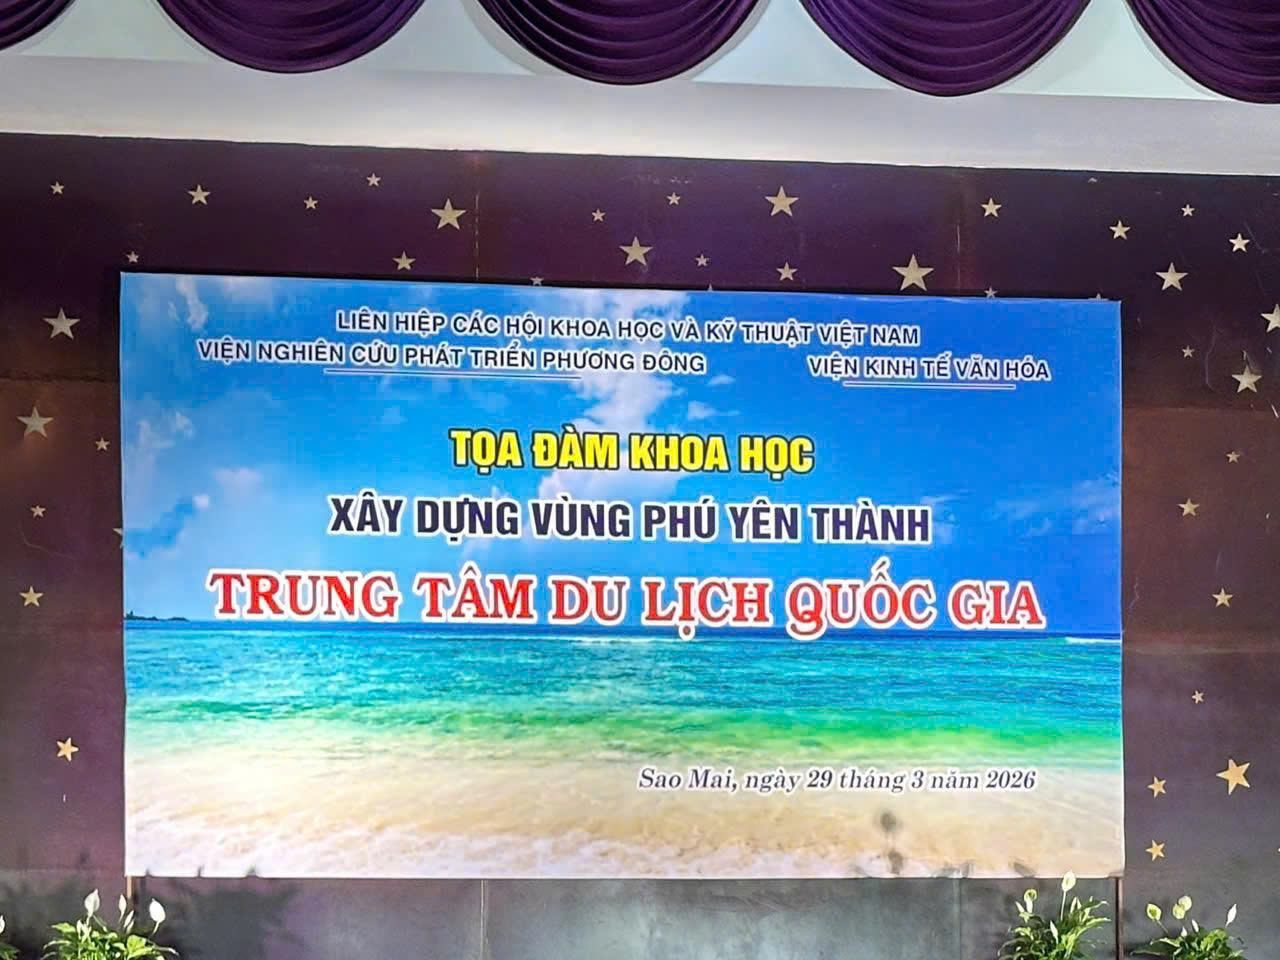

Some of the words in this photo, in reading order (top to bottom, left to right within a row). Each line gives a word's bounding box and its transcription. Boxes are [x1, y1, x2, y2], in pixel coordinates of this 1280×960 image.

[338, 310, 386, 330] LIÊN
[395, 312, 445, 337] HIỆP
[453, 313, 498, 334] CÁC
[506, 315, 543, 340] HỘI
[551, 319, 610, 337] KHOA
[618, 320, 663, 344] HỌC
[671, 318, 698, 340] VÀ
[706, 319, 734, 340] KỸ
[742, 321, 811, 346] THUẬT
[819, 323, 865, 348] VIỆT
[873, 327, 919, 344] NAM
[199, 338, 250, 362] VIỆN
[258, 341, 343, 362] NGHIÊN
[352, 342, 397, 364] CỨU
[405, 343, 461, 365] PHÁT
[472, 342, 534, 368] TRIỂN
[543, 349, 634, 370] PHƯƠNG
[643, 350, 704, 371] ĐÔNG
[808, 355, 858, 379] VIỆN
[866, 359, 915, 376] KINH
[923, 353, 950, 377] TẾ
[957, 356, 997, 378] VĂN
[1006, 356, 1049, 378] HÓA
[450, 429, 523, 474] TỌA
[532, 425, 619, 469] ĐÀM
[630, 433, 729, 471] KHOA
[739, 435, 815, 480] HỌC
[330, 492, 403, 532] XÂY
[417, 498, 518, 541] DỰNG
[531, 496, 630, 536] VÙNG
[644, 499, 715, 538] PHÚ
[729, 500, 798, 540] YÊN
[811, 501, 929, 541] THÀNH
[210, 573, 399, 617] TRUNG
[417, 566, 535, 619] TÂM
[552, 578, 625, 621] DU
[644, 581, 771, 635] LỊCH
[789, 560, 934, 635] QUỐC
[951, 584, 1043, 625] GIA
[639, 768, 681, 788] Sao
[688, 768, 737, 791] Mai,
[745, 769, 801, 792] ngày
[807, 769, 832, 789] 29
[839, 769, 905, 791] tháng
[911, 770, 924, 788] 3
[930, 770, 979, 789] năm
[985, 770, 1036, 789] 2026
